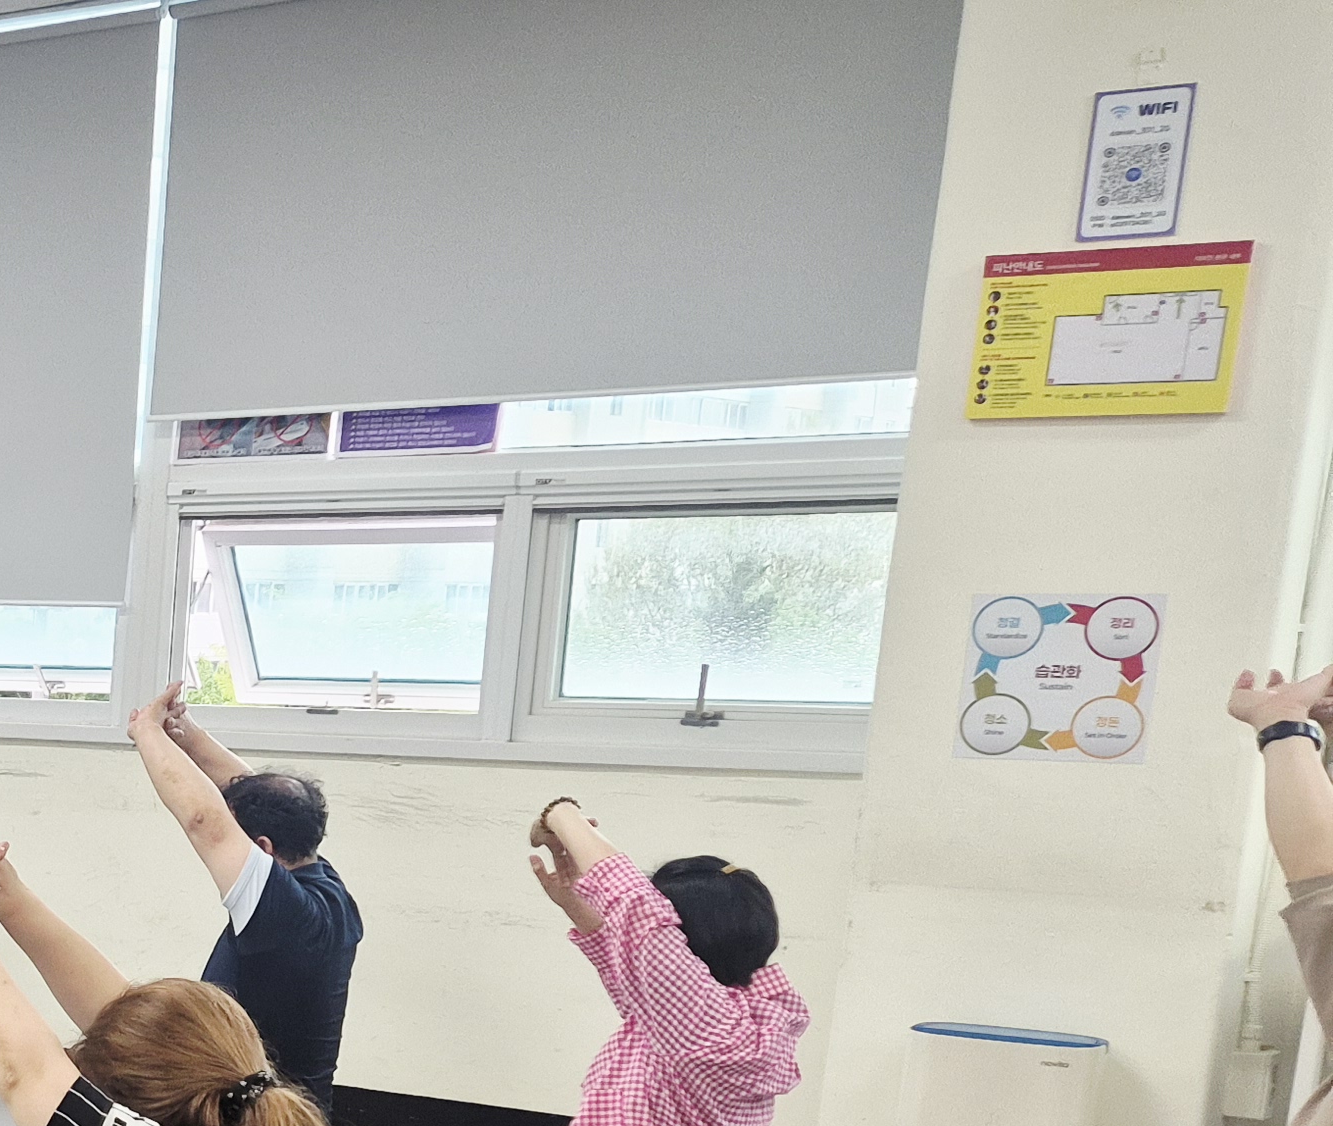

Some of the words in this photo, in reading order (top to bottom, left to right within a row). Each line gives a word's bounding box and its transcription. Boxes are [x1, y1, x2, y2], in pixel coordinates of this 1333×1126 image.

[1139, 101, 1179, 117] WIFI
[1110, 617, 1135, 629] 정리
[1035, 664, 1082, 679] 습관화
[1038, 682, 1074, 690] Sustain
[984, 713, 1008, 725] 청소
